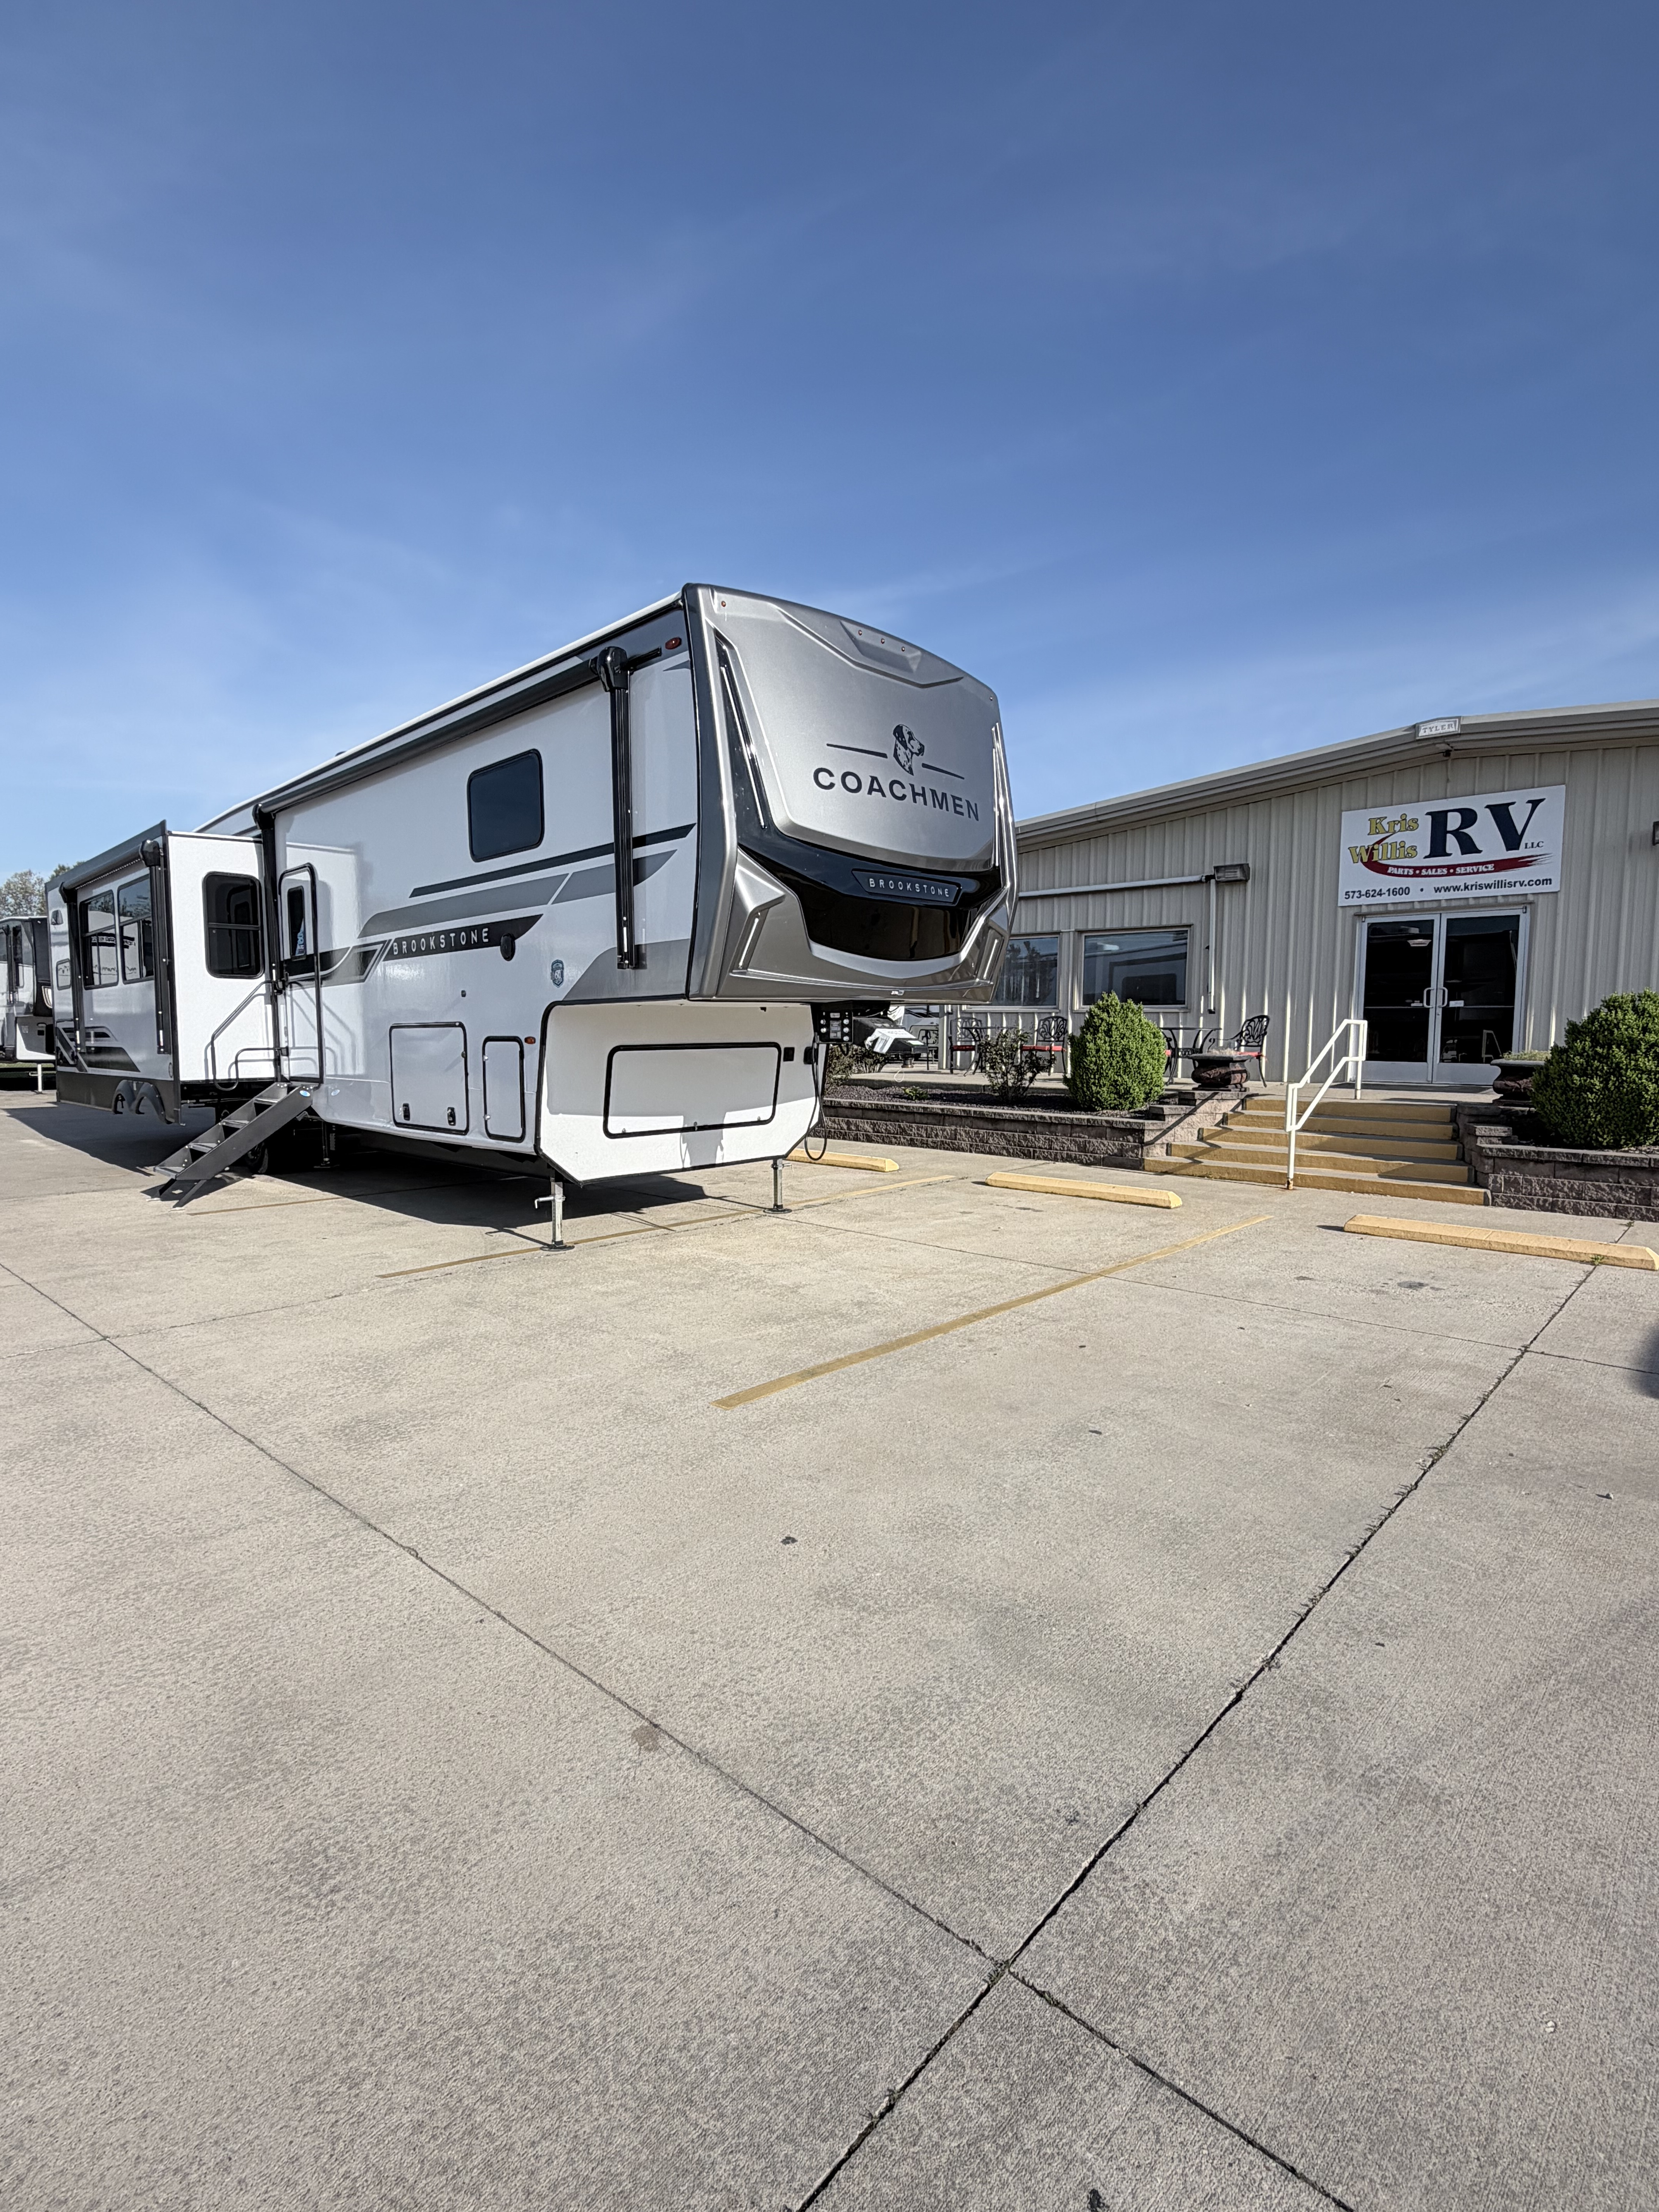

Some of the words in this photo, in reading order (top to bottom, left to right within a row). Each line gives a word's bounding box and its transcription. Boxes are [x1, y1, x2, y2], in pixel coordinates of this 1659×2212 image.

[1422, 723, 1454, 733] TYLER
[813, 767, 979, 821] COACHMEN
[1348, 840, 1418, 864] Willis
[1423, 798, 1546, 859] RV
[1524, 841, 1544, 849] LLC
[1367, 813, 1419, 836] Kris
[1387, 867, 1414, 875] PARTS
[1455, 864, 1495, 874] SERVICE
[869, 878, 949, 897] BROOKSTONE
[1344, 886, 1410, 900] 573-624-1600
[1434, 878, 1552, 893] www.kriswillisrv.com
[392, 928, 489, 955] BROOKSTONE
